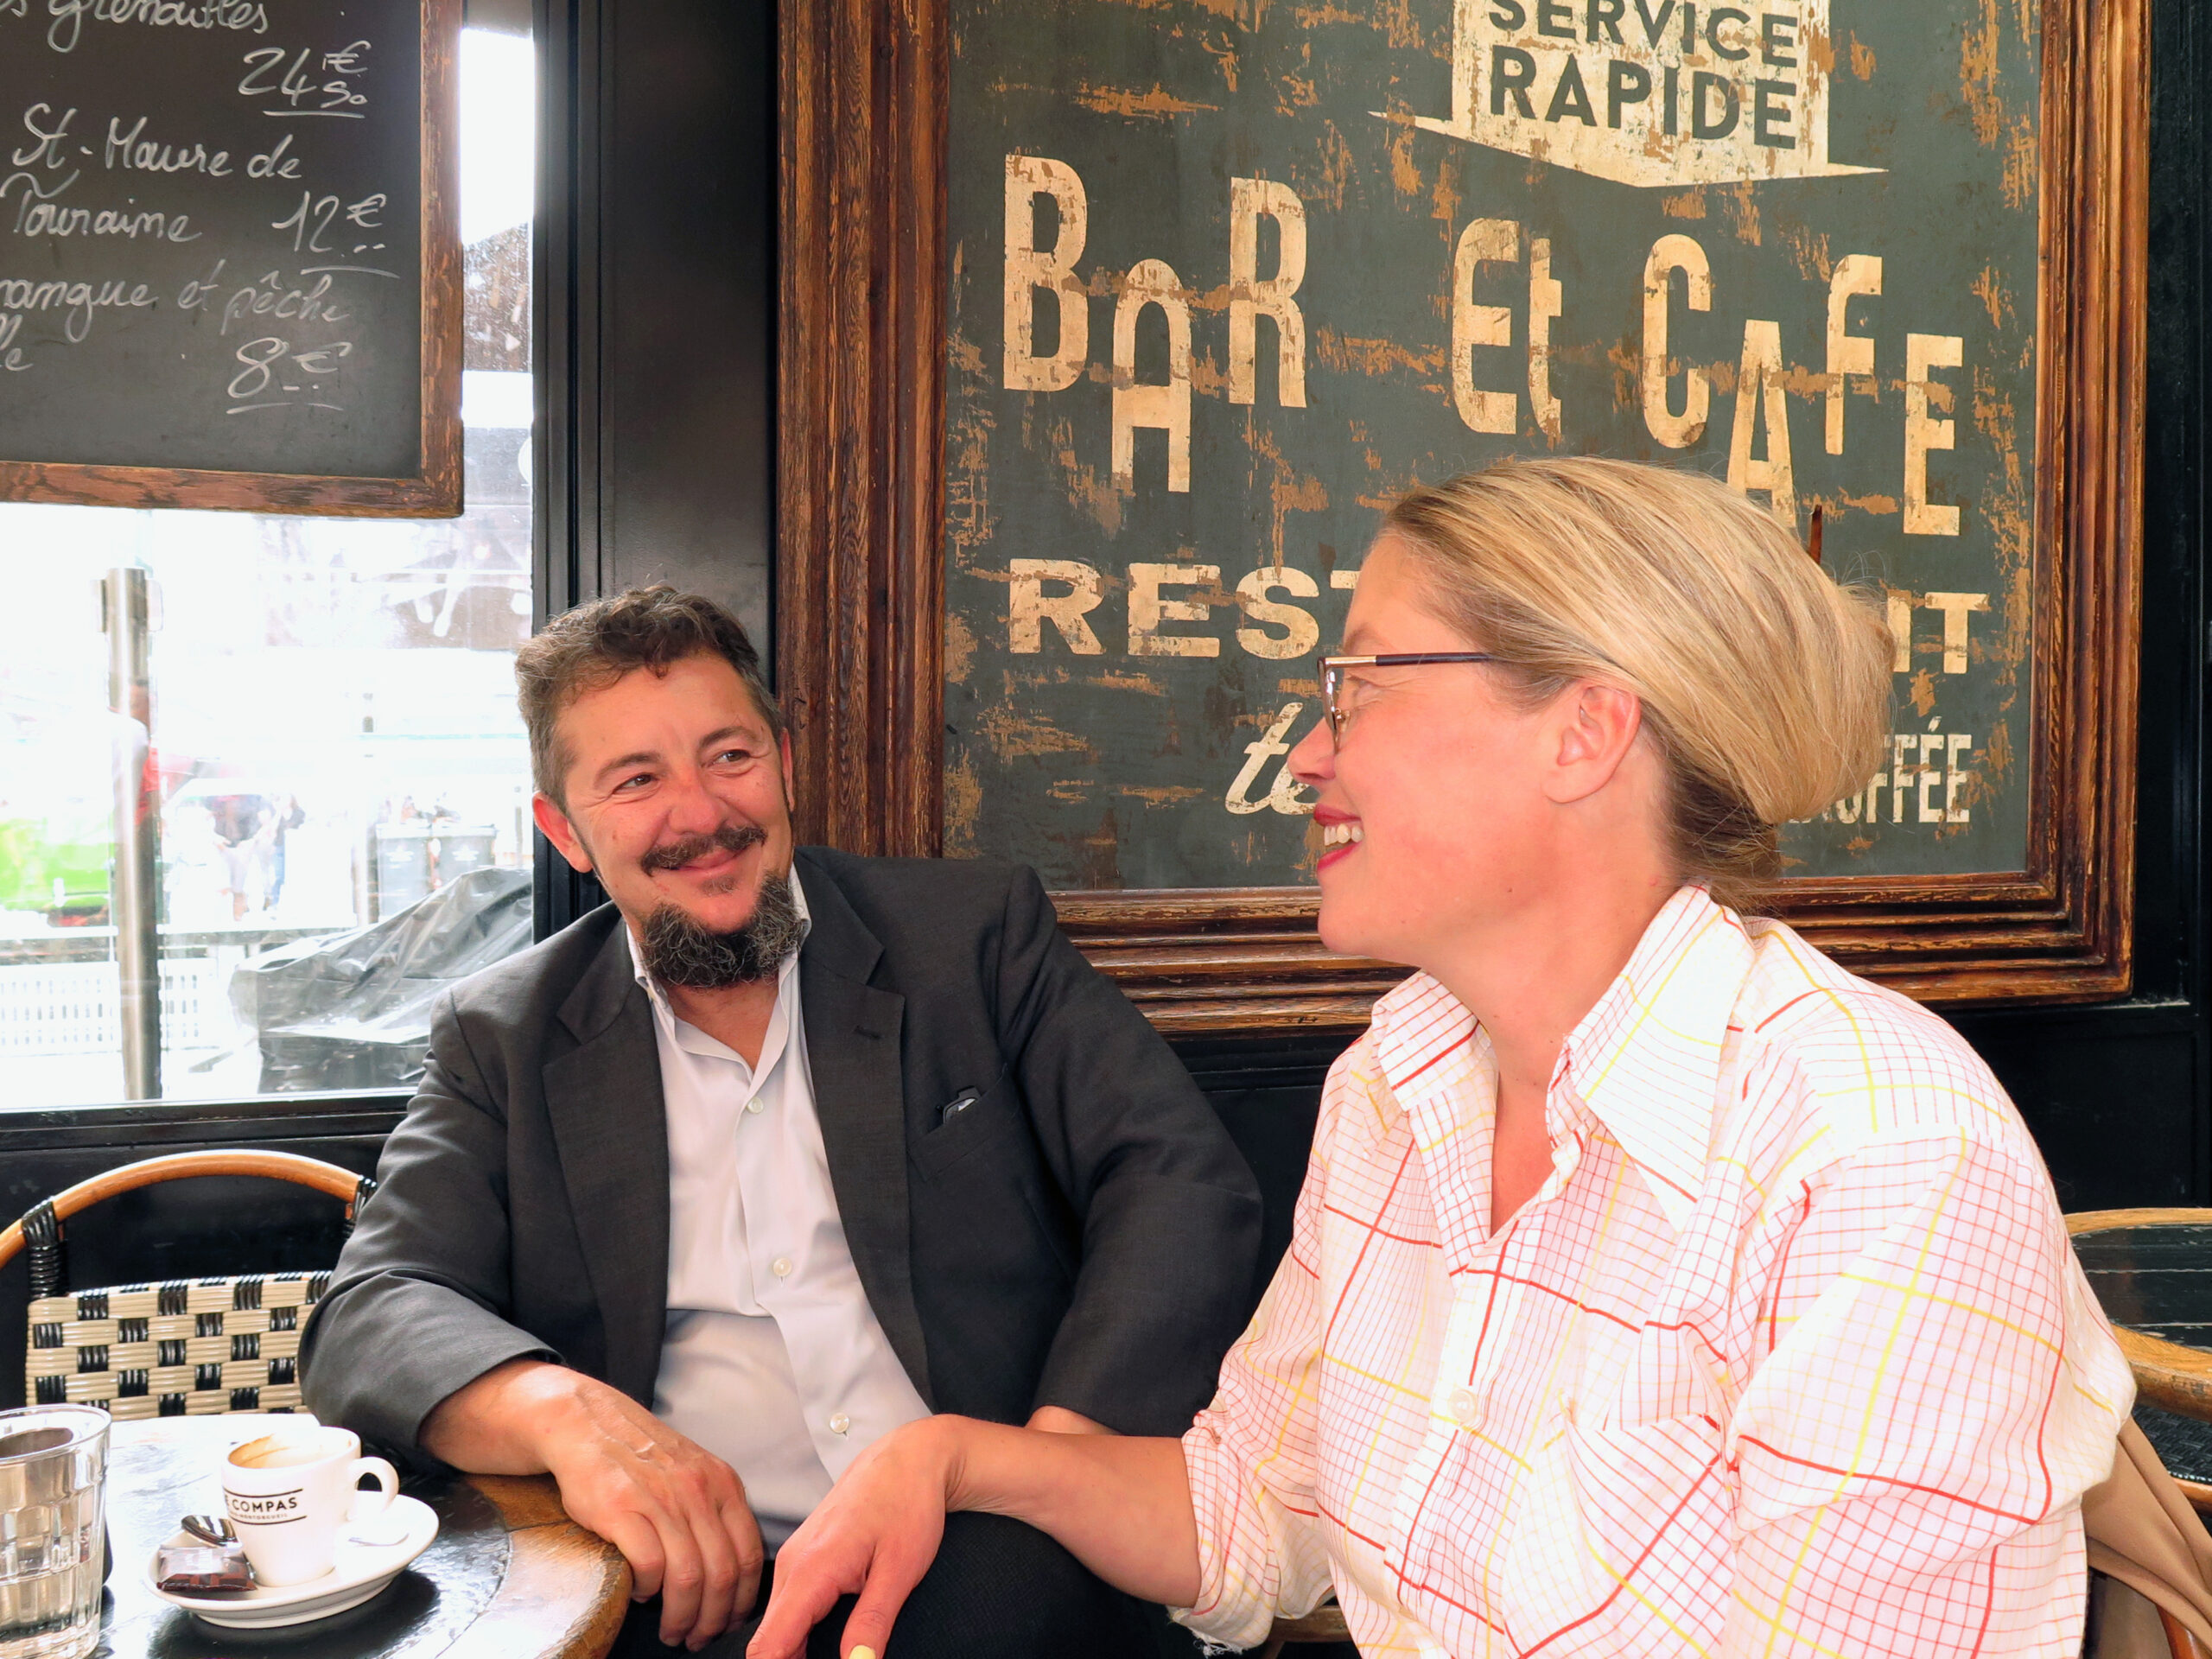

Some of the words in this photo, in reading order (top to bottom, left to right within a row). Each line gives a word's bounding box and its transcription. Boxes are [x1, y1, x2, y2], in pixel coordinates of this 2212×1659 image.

[1489, 0, 1797, 67] SERVICE
[1491, 45, 1796, 149] RAPIDE
[247, 134, 302, 179] de
[0, 169, 202, 243] Touraine
[178, 259, 228, 311] et
[220, 270, 350, 335] pêche
[1003, 154, 1308, 493] BAR
[1452, 218, 1562, 435] Et
[232, 1497, 298, 1512] COMPAS
